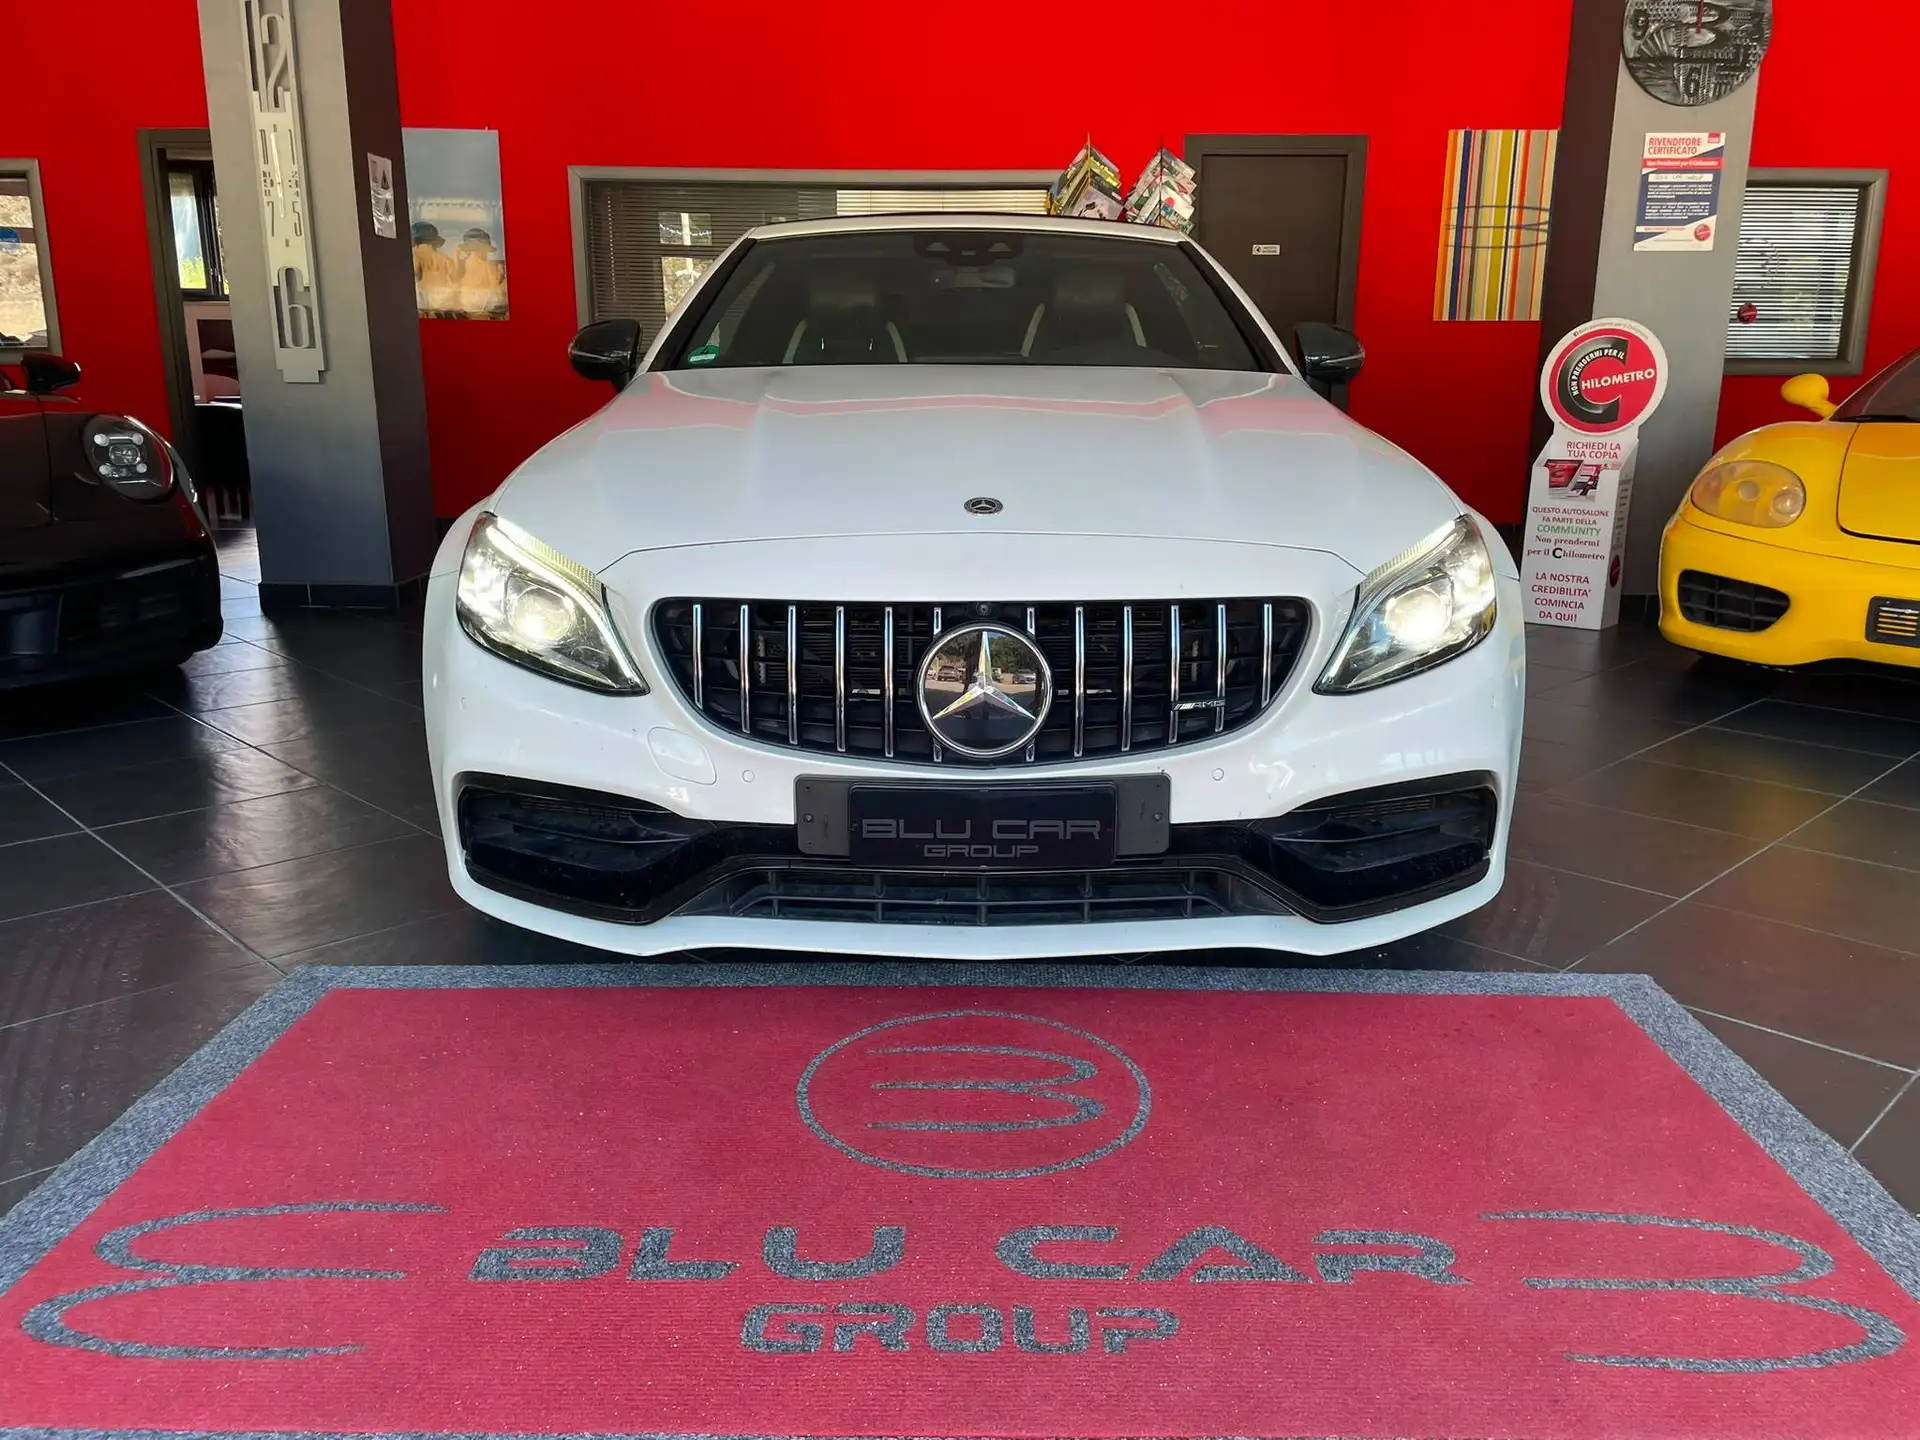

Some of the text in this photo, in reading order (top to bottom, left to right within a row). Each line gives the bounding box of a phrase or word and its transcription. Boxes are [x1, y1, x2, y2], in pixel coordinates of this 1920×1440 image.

[1648, 137, 1702, 146] RIVENDITORE
[1647, 146, 1698, 155] CERTIFICATO
[279, 265, 310, 349] 6
[1570, 348, 1626, 396] NON PRENDERMI PER IL
[1566, 441, 1621, 451] RICHIEDI LA
[1568, 450, 1618, 459] TUA COPIA
[1532, 506, 1609, 518] QUESTO AUTOSALONE
[1552, 516, 1573, 524] PARTE
[1575, 518, 1597, 526] DELLA
[1537, 525, 1601, 537] COMMUNITY
[1535, 535, 1600, 547] Non prendermi
[1527, 547, 1606, 560] per il Chilometro
[1535, 572, 1590, 585] LA NOSTRA
[1534, 597, 1585, 610] COMINCIA
[1538, 610, 1578, 623] DA QUI!
[861, 818, 1102, 840] BLU CAR
[923, 844, 1040, 858] GROUP
[468, 1224, 1475, 1285] BLU CAR
[740, 1302, 1181, 1355] GROUP
